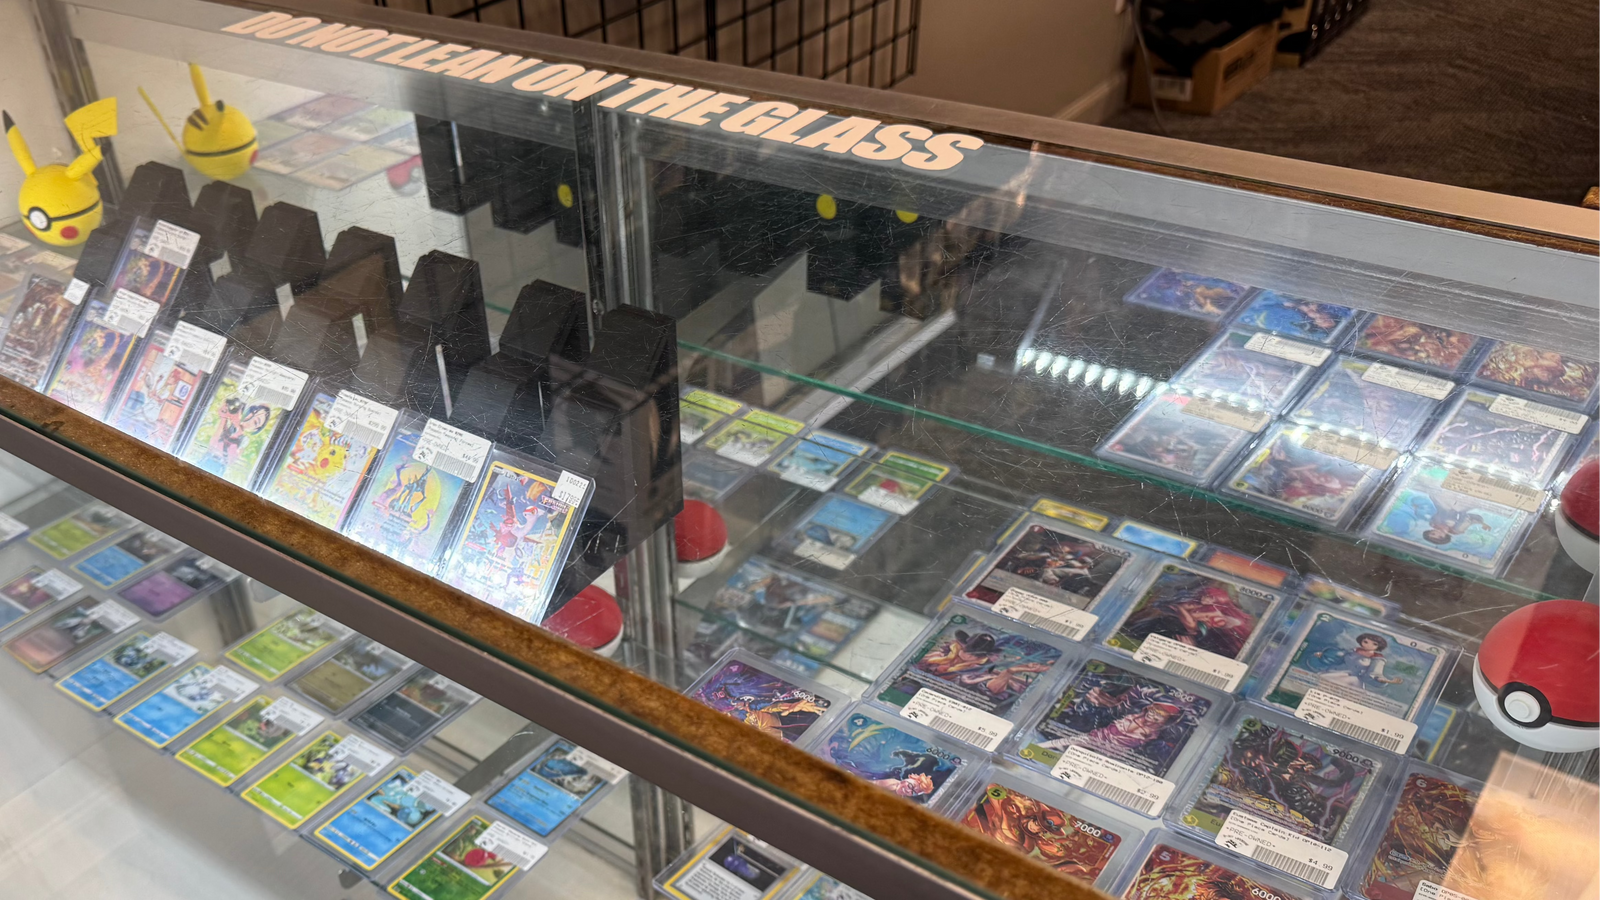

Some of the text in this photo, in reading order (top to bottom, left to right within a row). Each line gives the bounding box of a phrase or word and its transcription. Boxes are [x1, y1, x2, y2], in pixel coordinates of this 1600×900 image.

[221, 12, 984, 171] DO NOT LEAN ON THE GLASS
[1332, 749, 1359, 763] 9000
[1415, 778, 1427, 788] 6
[991, 788, 1003, 798] 5
[1074, 821, 1101, 838] 7000
[1159, 851, 1171, 861] 5
[1307, 858, 1333, 870] $4.99
